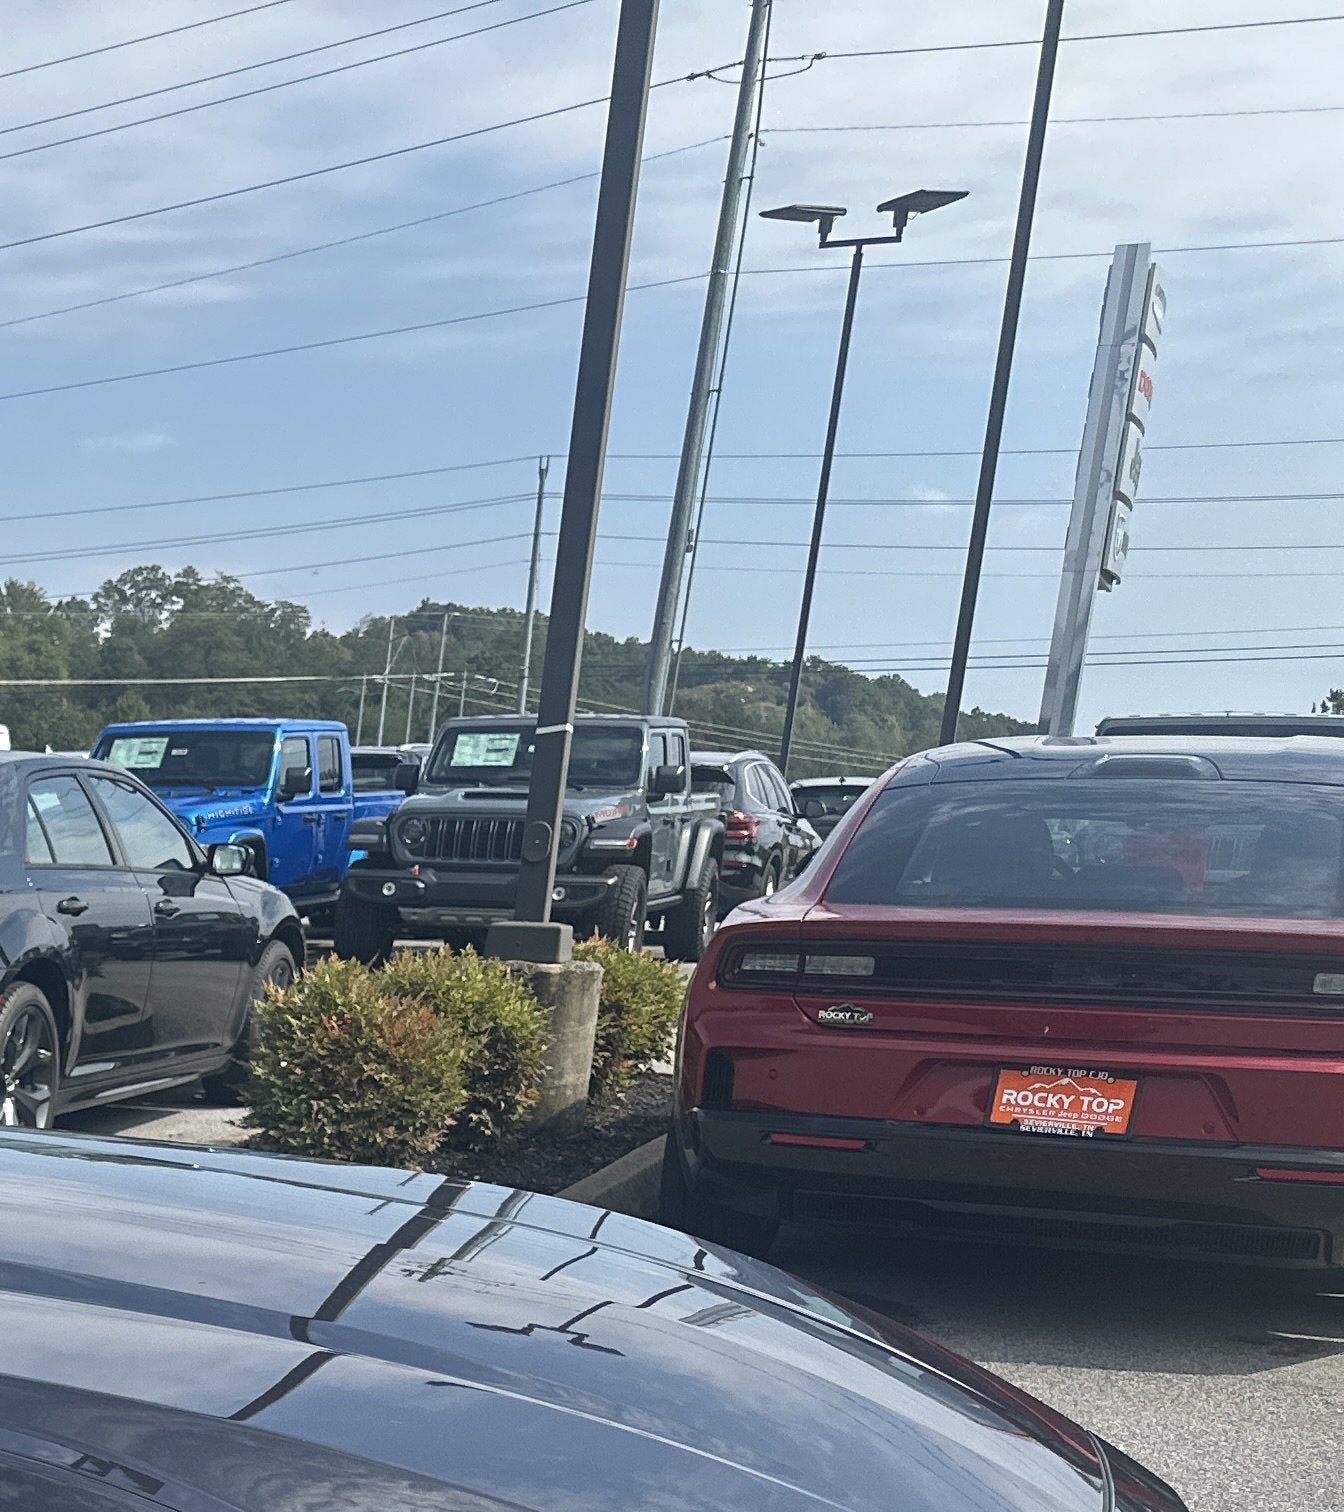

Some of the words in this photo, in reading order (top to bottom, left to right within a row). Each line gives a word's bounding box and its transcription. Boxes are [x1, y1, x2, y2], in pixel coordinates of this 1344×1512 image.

[818, 1009, 852, 1020] ROCKY
[1029, 1065, 1062, 1077] ROCKY
[1066, 1068, 1087, 1078] TOP
[1001, 1089, 1076, 1110] ROCKY
[1079, 1095, 1125, 1114] TOP
[998, 1104, 1055, 1117] CHRYSLER
[1057, 1110, 1079, 1120] Jeep
[1080, 1112, 1123, 1122] DODGE
